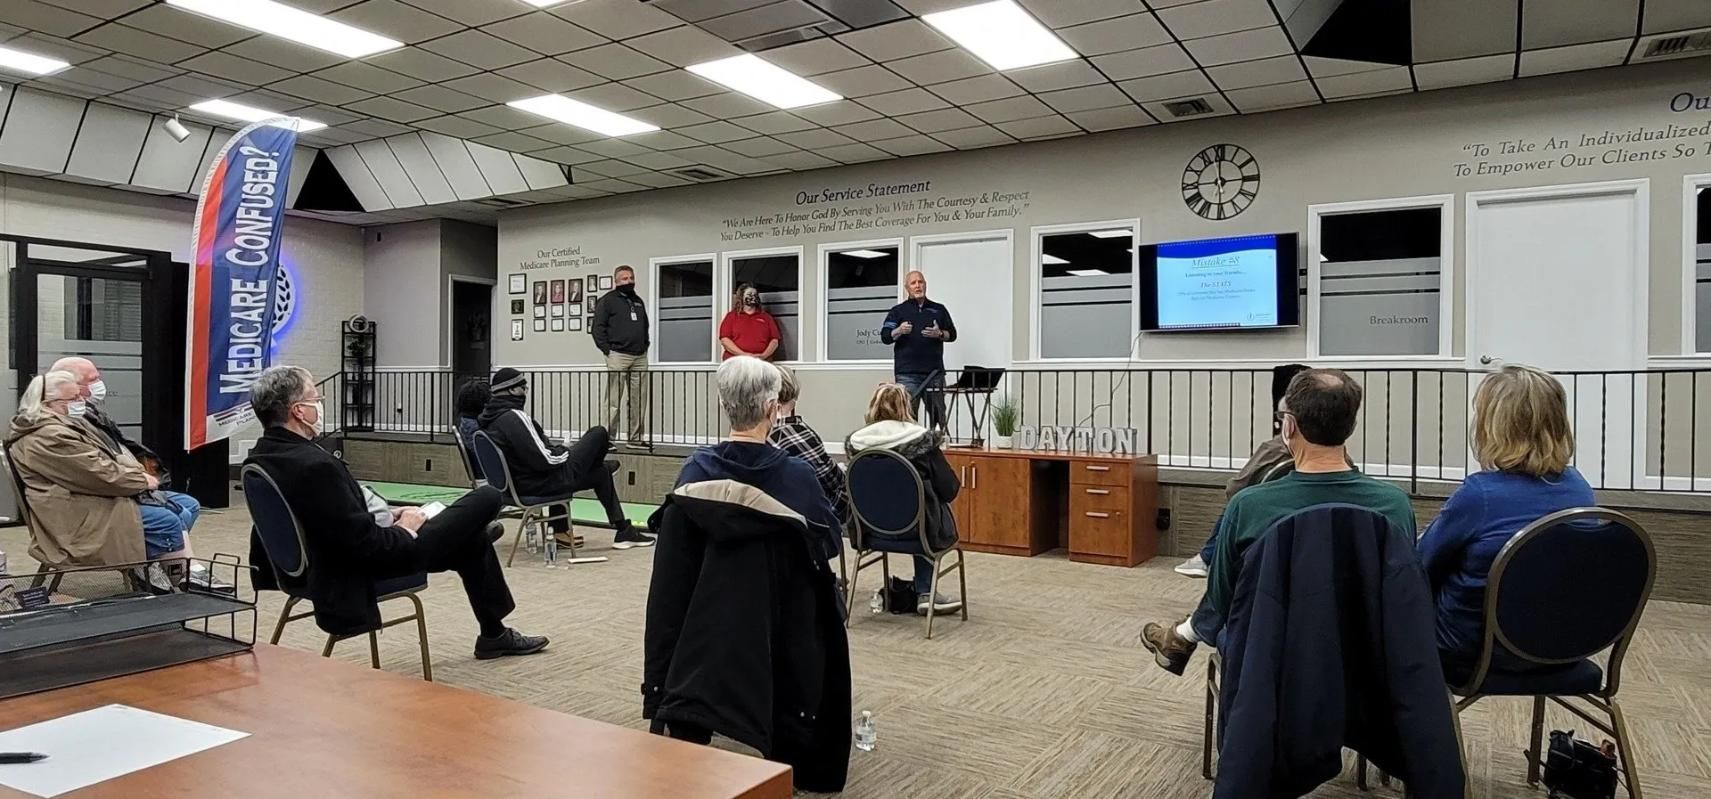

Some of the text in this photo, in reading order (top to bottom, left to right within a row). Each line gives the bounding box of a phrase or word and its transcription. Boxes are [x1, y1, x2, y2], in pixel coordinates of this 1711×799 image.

[1499, 139, 1536, 155] Take
[1544, 136, 1569, 151] An
[1579, 120, 1711, 148] Individualized
[1453, 163, 1472, 177] To
[1477, 158, 1556, 176] Empower
[1560, 153, 1597, 168] Our
[1602, 148, 1667, 165] Clients
[1671, 143, 1696, 159] So
[740, 217, 754, 228] Are
[754, 215, 773, 226] Here
[775, 213, 785, 224] To
[785, 212, 810, 223] Honor
[811, 209, 828, 220] God
[829, 207, 840, 218] By
[842, 206, 872, 217] Serving
[875, 203, 891, 214] You
[893, 201, 915, 211] With
[917, 198, 935, 210] The
[936, 195, 979, 208] Courtesy
[979, 193, 989, 204] &
[991, 190, 1030, 202] Respect
[795, 180, 931, 206] Our Service Statement
[721, 231, 733, 242] You
[734, 229, 764, 241] Deserve
[771, 226, 780, 237] To
[782, 225, 800, 238] Help
[802, 223, 816, 235] You
[818, 221, 836, 233] Find
[838, 219, 854, 231] The
[855, 218, 873, 229] Best
[875, 215, 915, 228] Coverage
[916, 213, 932, 224] For
[933, 211, 950, 223] You
[952, 210, 961, 221] &
[964, 208, 985, 220] Your
[520, 256, 600, 271] Medicare Planning Team
[537, 245, 581, 259] Our Certified
[219, 144, 280, 395] MEDICARE CONFUSED?
[1369, 315, 1429, 325] Breakroom
[1020, 424, 1137, 455] DAYTON
